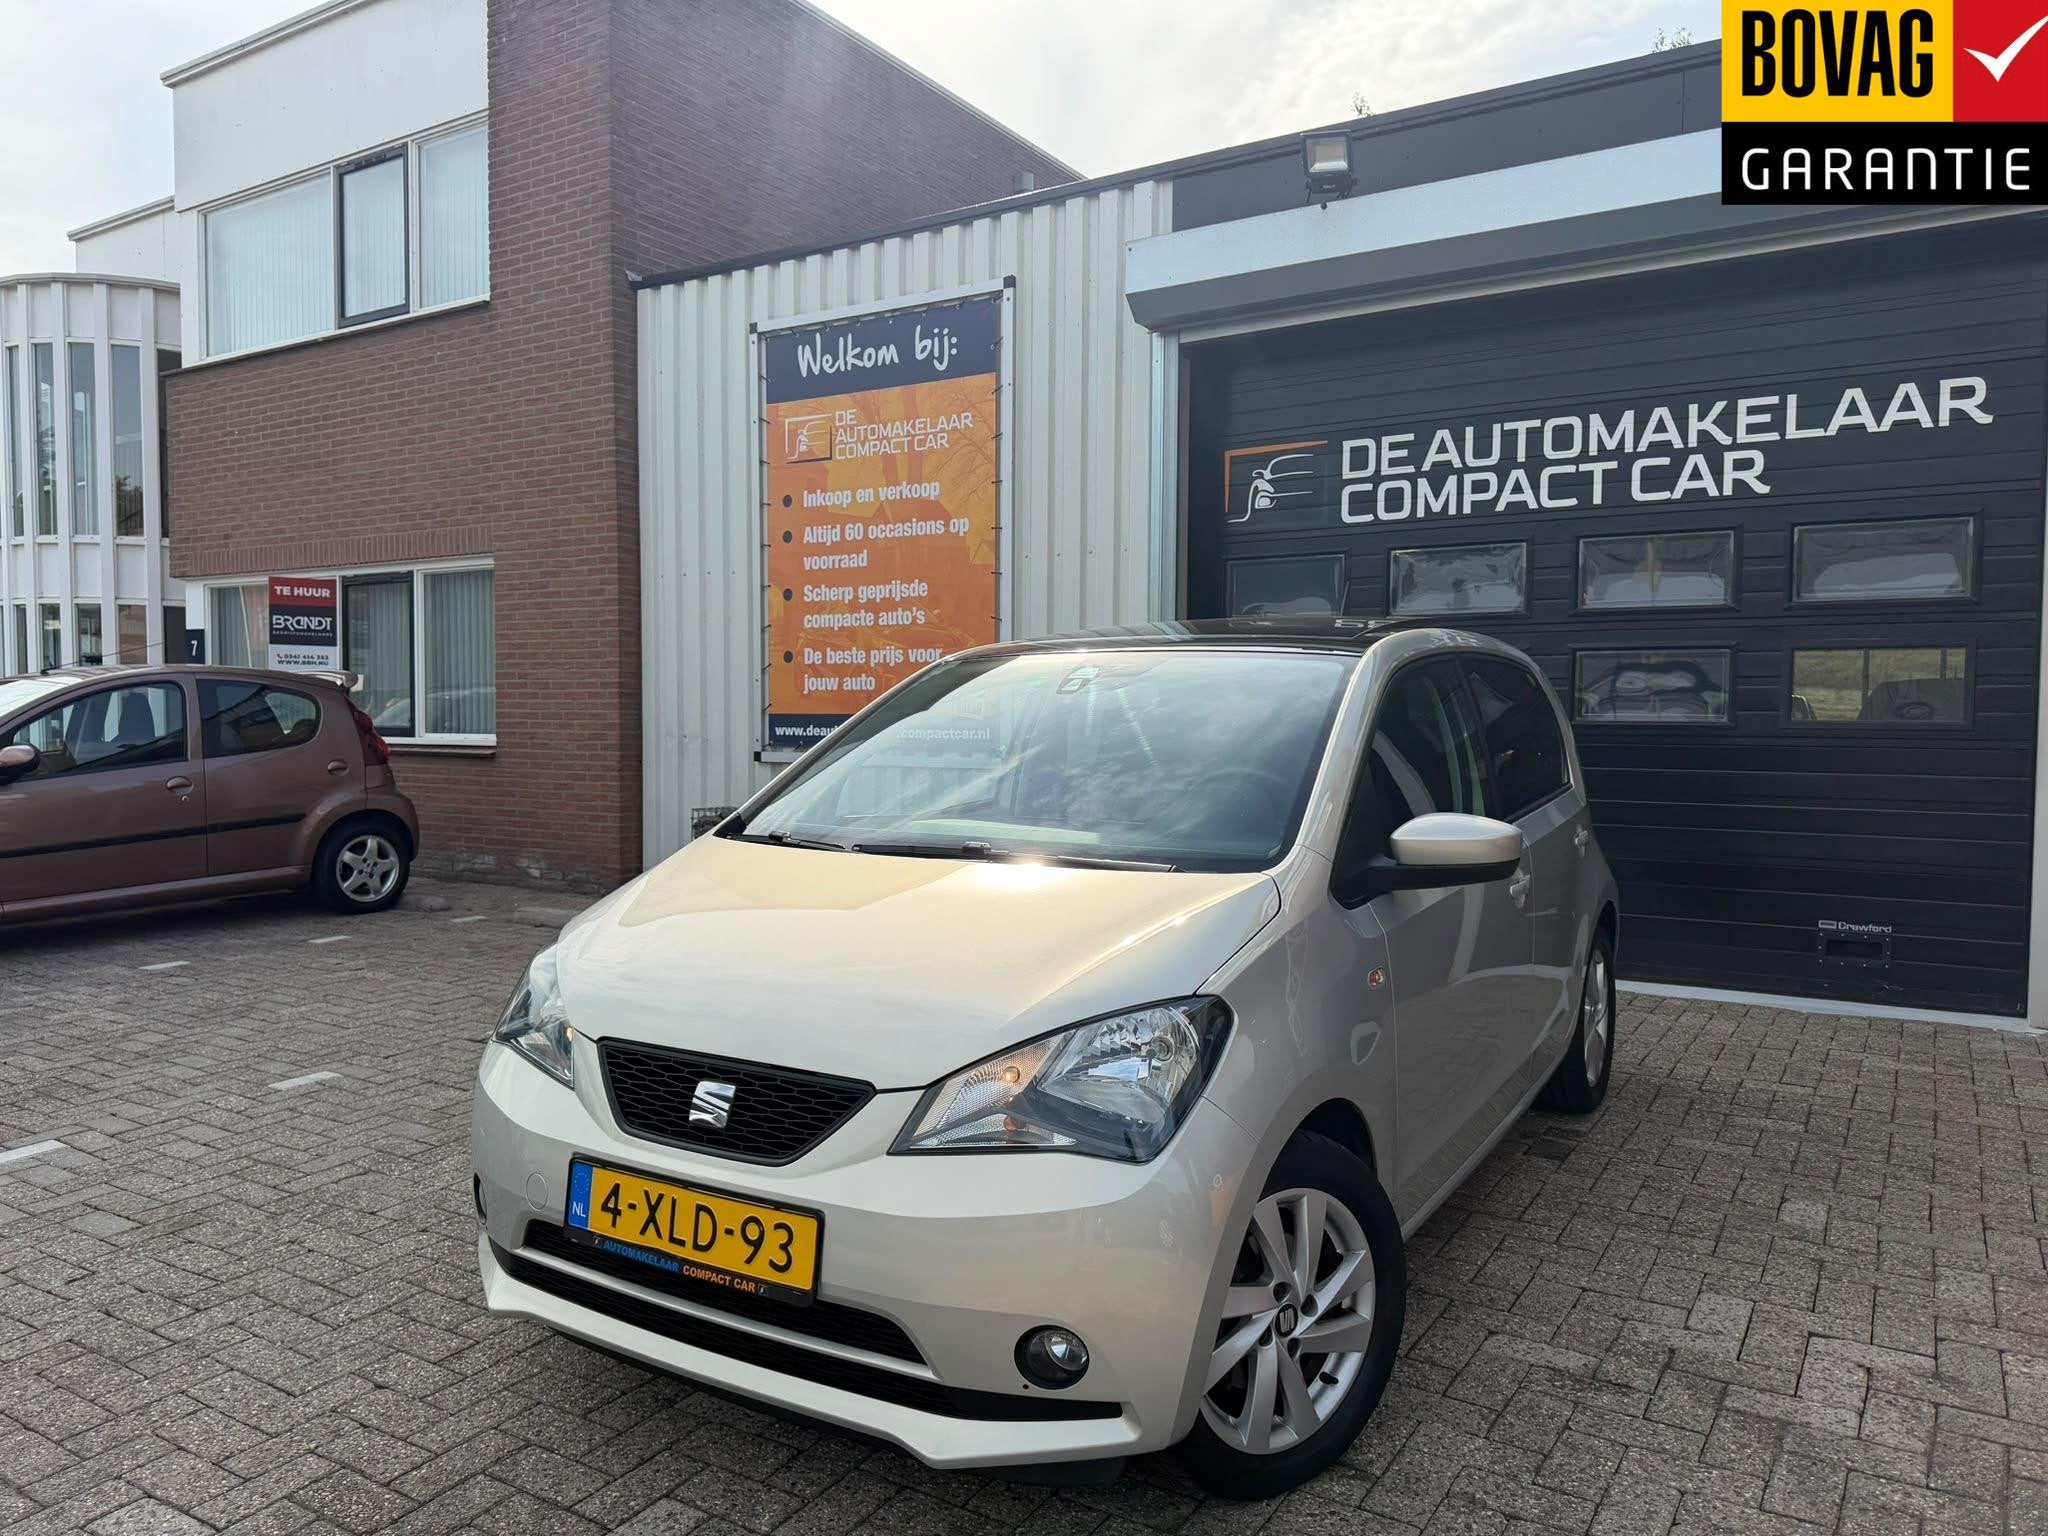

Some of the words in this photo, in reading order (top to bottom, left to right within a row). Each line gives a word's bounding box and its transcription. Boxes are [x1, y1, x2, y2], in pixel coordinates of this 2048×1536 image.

[797, 332, 900, 378] Welkom
[914, 324, 958, 371] bij:
[835, 409, 857, 426] DE
[835, 412, 974, 445] AUTOMAKELAAR
[1341, 432, 1416, 480] DE
[1420, 376, 1994, 471] AUTOMAKELAAR
[835, 436, 912, 460] COMPACT
[914, 432, 950, 451] CAR
[803, 488, 852, 508] Inkoop
[856, 487, 874, 502] en
[879, 481, 940, 502] verkoop
[1340, 460, 1619, 524] COMPACT
[1630, 450, 1771, 503] CAR
[803, 523, 841, 546] Altijd
[845, 522, 864, 541] 60
[868, 518, 945, 539] occasions
[949, 517, 969, 536] op
[803, 550, 868, 571] voorraad
[274, 585, 291, 597] TE
[293, 586, 331, 598] HUUR
[803, 584, 853, 604] Scherp
[858, 579, 928, 604] geprijsde
[272, 615, 333, 631] BRANDT
[803, 609, 875, 631] compacte
[878, 607, 926, 626] auto's
[191, 640, 198, 656] 7
[803, 647, 822, 665] De
[826, 646, 866, 665] beste
[870, 645, 904, 667] prijs
[908, 648, 943, 663] voor
[803, 674, 840, 695] jouw
[843, 674, 876, 691] auto
[1838, 921, 1892, 933] Crawford
[572, 1202, 587, 1218] NL
[600, 1182, 795, 1274] 4-XLD-93
[602, 1240, 680, 1273] AUTOMAKELAAR
[682, 1264, 732, 1287] COMPACT
[733, 1278, 758, 1293] CAR
